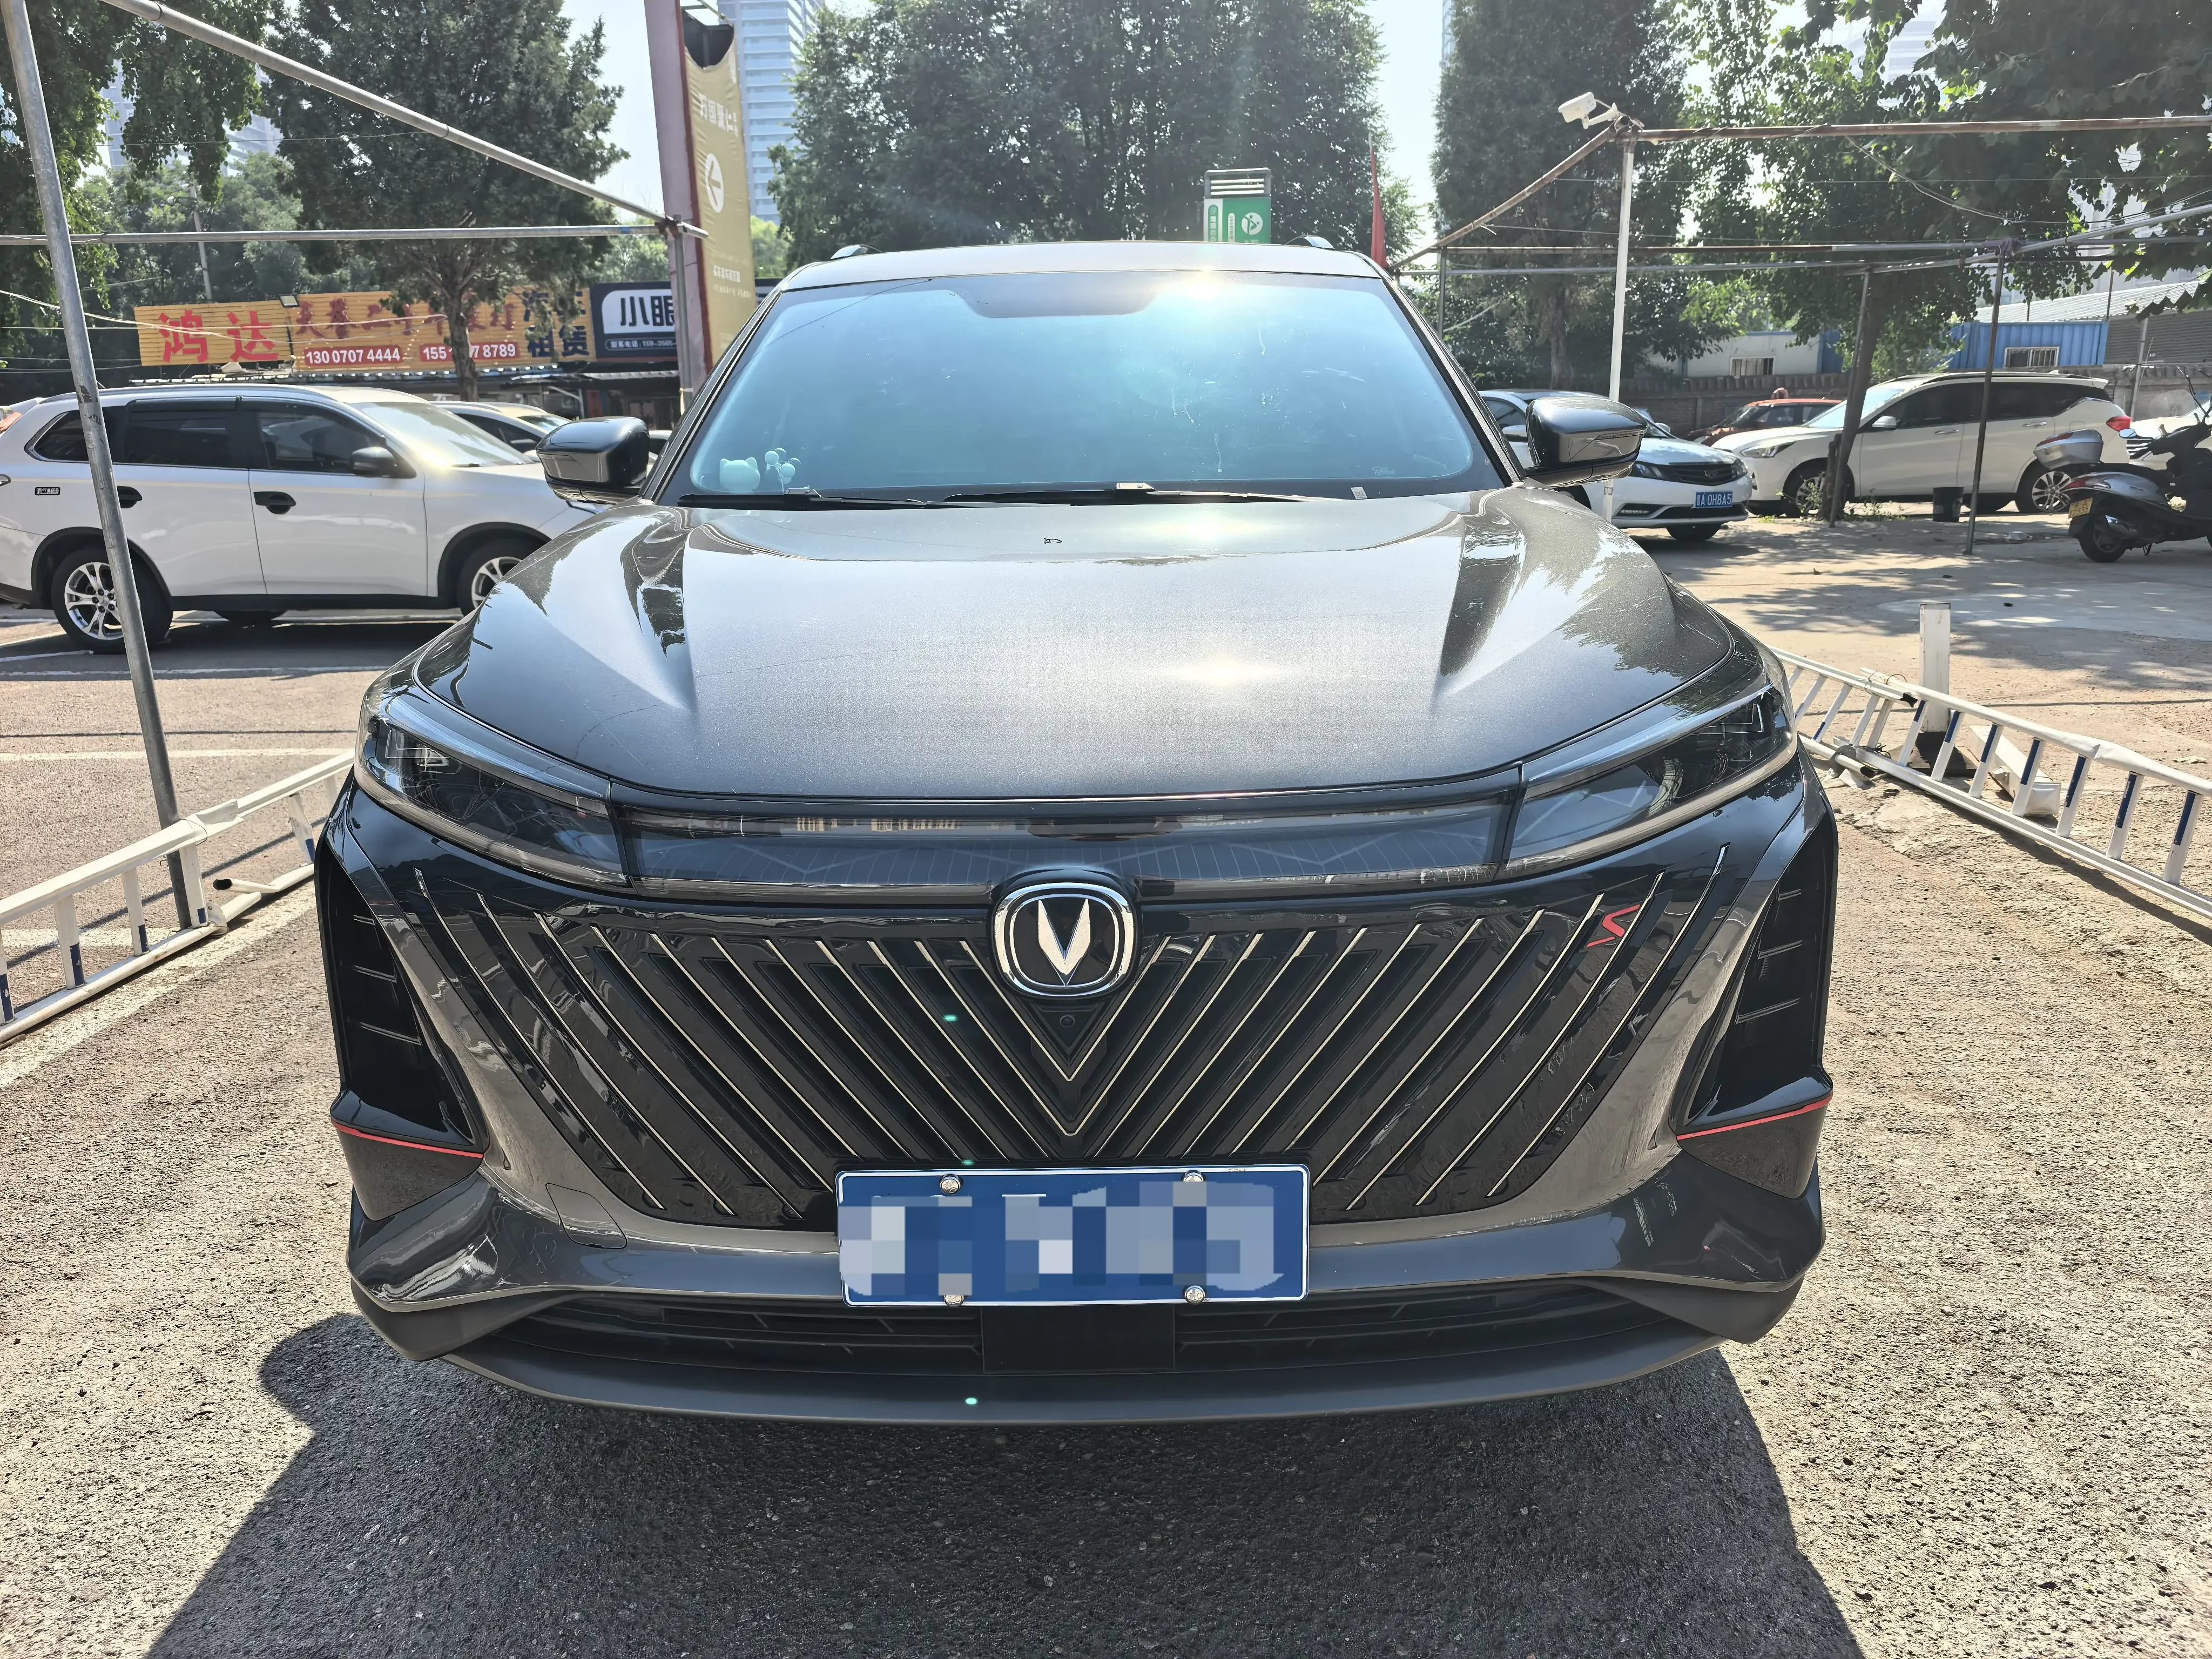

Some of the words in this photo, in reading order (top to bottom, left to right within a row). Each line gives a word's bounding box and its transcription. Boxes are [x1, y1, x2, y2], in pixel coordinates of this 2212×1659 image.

[158, 309, 279, 363] 鸿达
[306, 351, 330, 364] 130
[332, 349, 363, 363] 0707
[367, 348, 401, 362] 4444
[423, 346, 447, 360] 155
[482, 343, 515, 358] 8789
